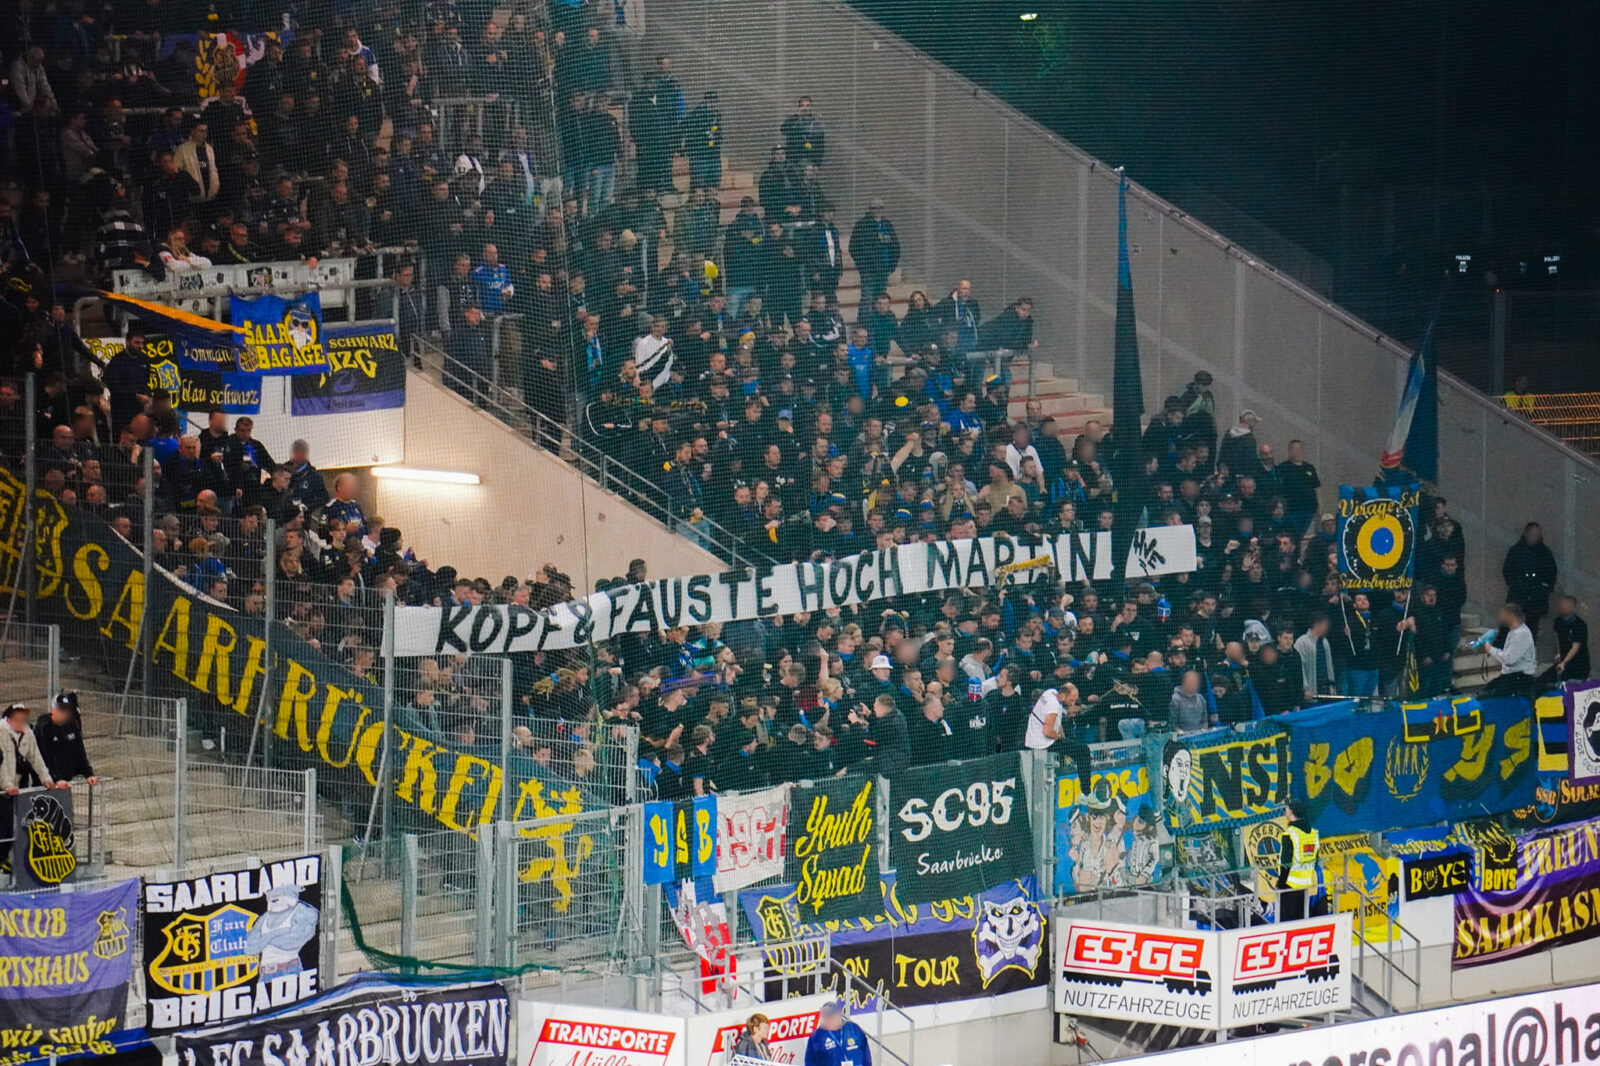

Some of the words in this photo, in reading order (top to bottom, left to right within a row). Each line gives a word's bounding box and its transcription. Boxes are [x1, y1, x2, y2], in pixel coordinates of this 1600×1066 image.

[243, 320, 290, 345] SAAR
[329, 333, 399, 352] SCHWARZ
[256, 343, 326, 370] BAGAGE
[182, 379, 207, 403] blau
[209, 383, 260, 405] schwarz
[1338, 498, 1395, 521] Virage
[1400, 491, 1421, 509] Est
[436, 602, 562, 655] KOPF
[573, 600, 595, 645] &
[607, 566, 779, 638] FÄUSTE
[796, 547, 903, 612] HOCH
[925, 530, 1098, 590] MARTIN
[795, 780, 873, 857] Youth
[898, 776, 1016, 842] SC95
[917, 843, 1004, 876] Saarbrücke
[145, 857, 320, 913] SAARLAND
[796, 843, 871, 915] Squad
[1484, 867, 1518, 891] BOYS
[211, 918, 246, 937] Fan
[210, 937, 248, 954] Club
[895, 953, 961, 988] TOUR
[149, 968, 318, 1030] BRIGADE
[1063, 989, 1212, 1021] NUTZFAHRZEUGE
[1232, 987, 1340, 1020] NUTZFAHRZEUGE
[548, 1021, 669, 1053] TRANSPORTE
[720, 1014, 816, 1048] TRPORTE
